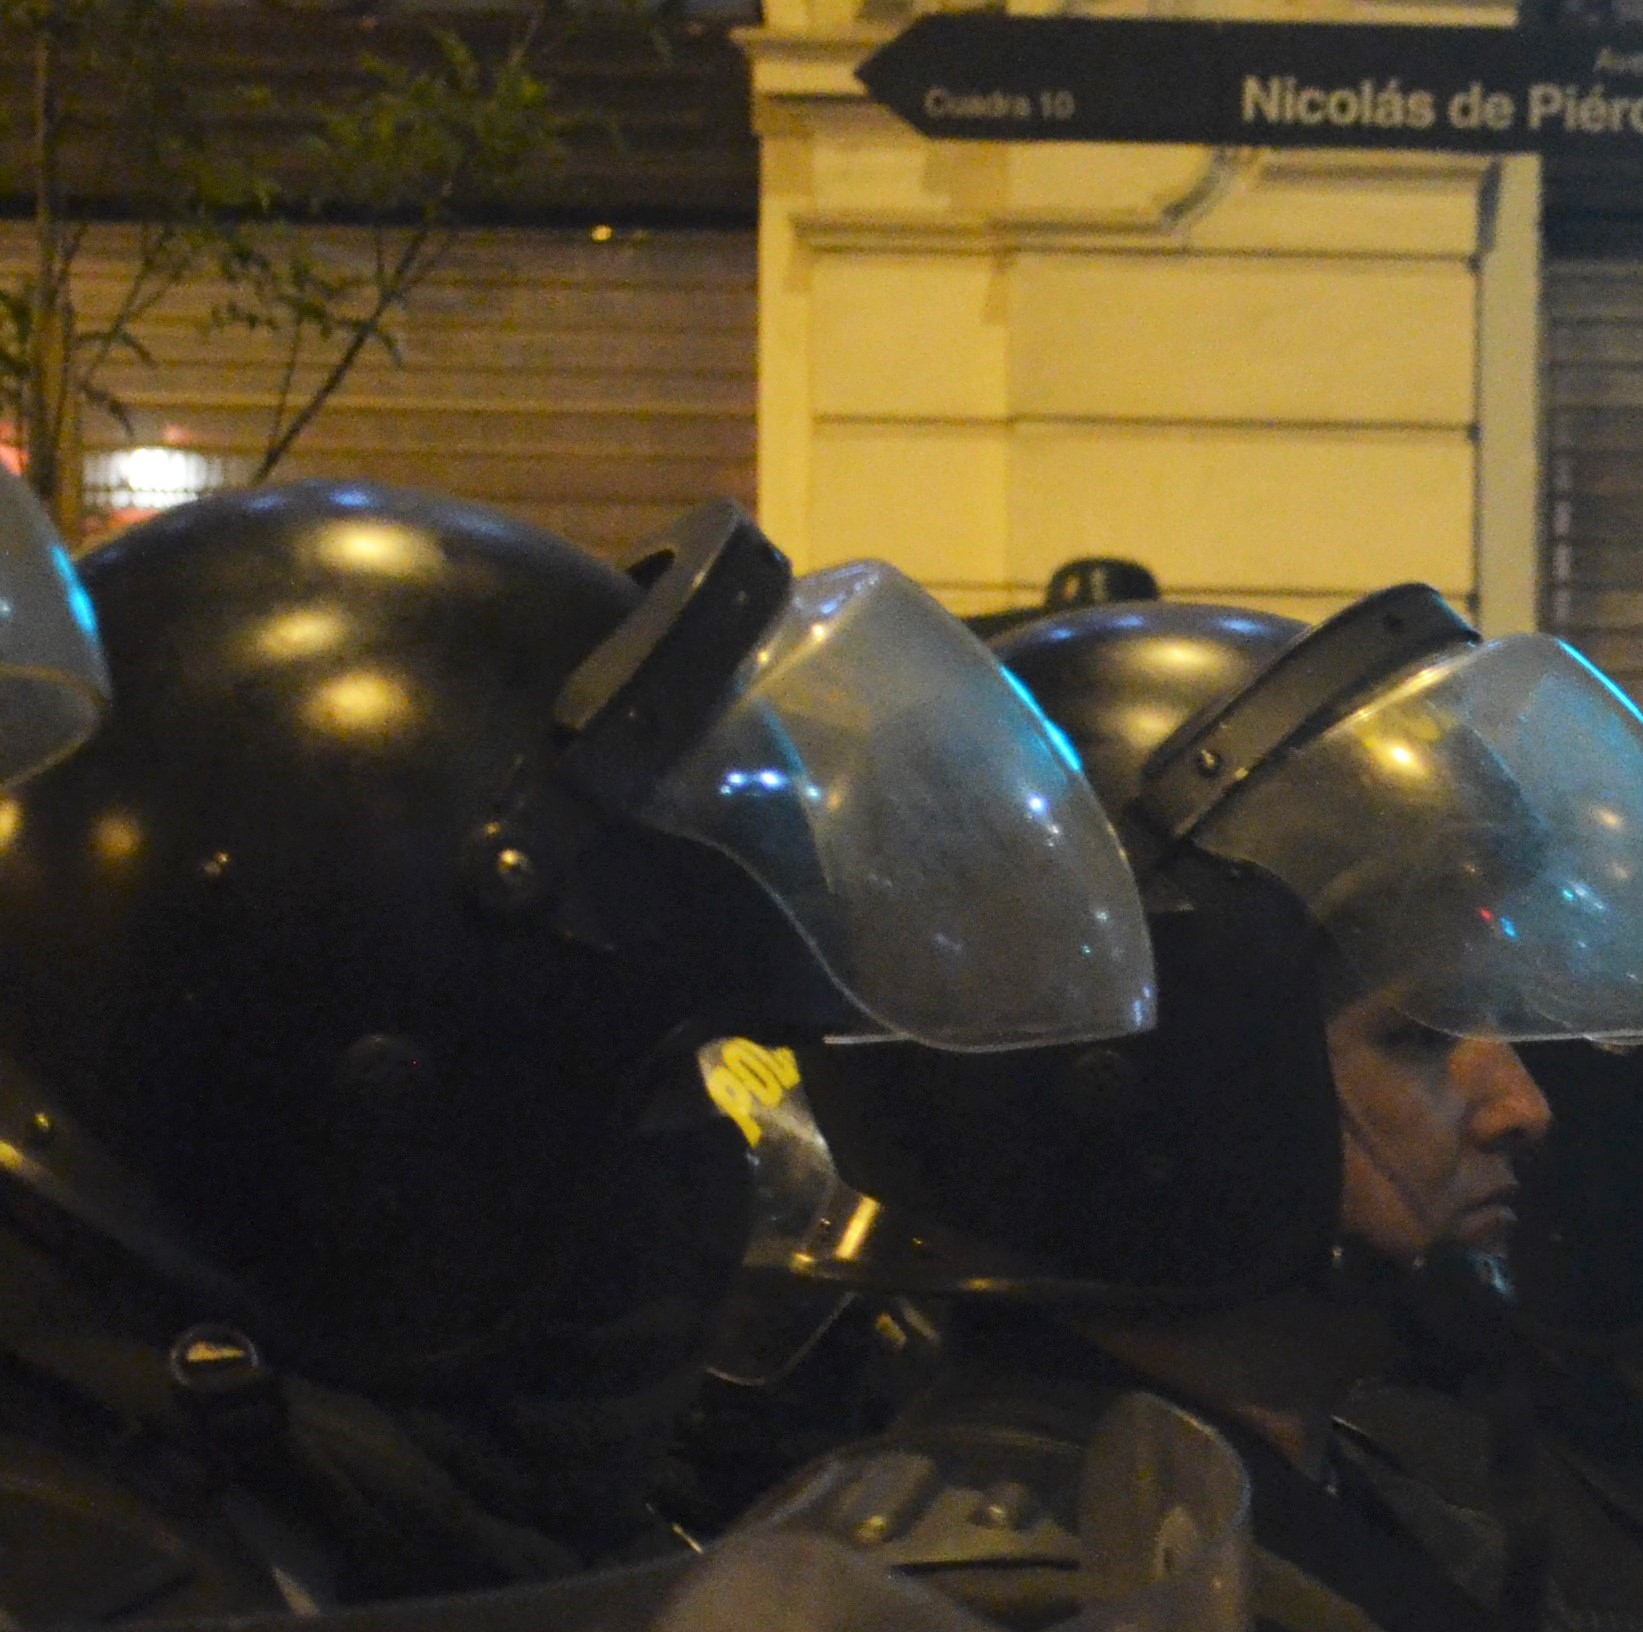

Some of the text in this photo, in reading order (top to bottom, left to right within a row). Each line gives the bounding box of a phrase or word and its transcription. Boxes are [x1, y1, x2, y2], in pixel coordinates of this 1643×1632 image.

[923, 85, 1076, 121] Cuadra 10
[1240, 74, 1436, 130] Nicolás
[1447, 82, 1515, 131] de
